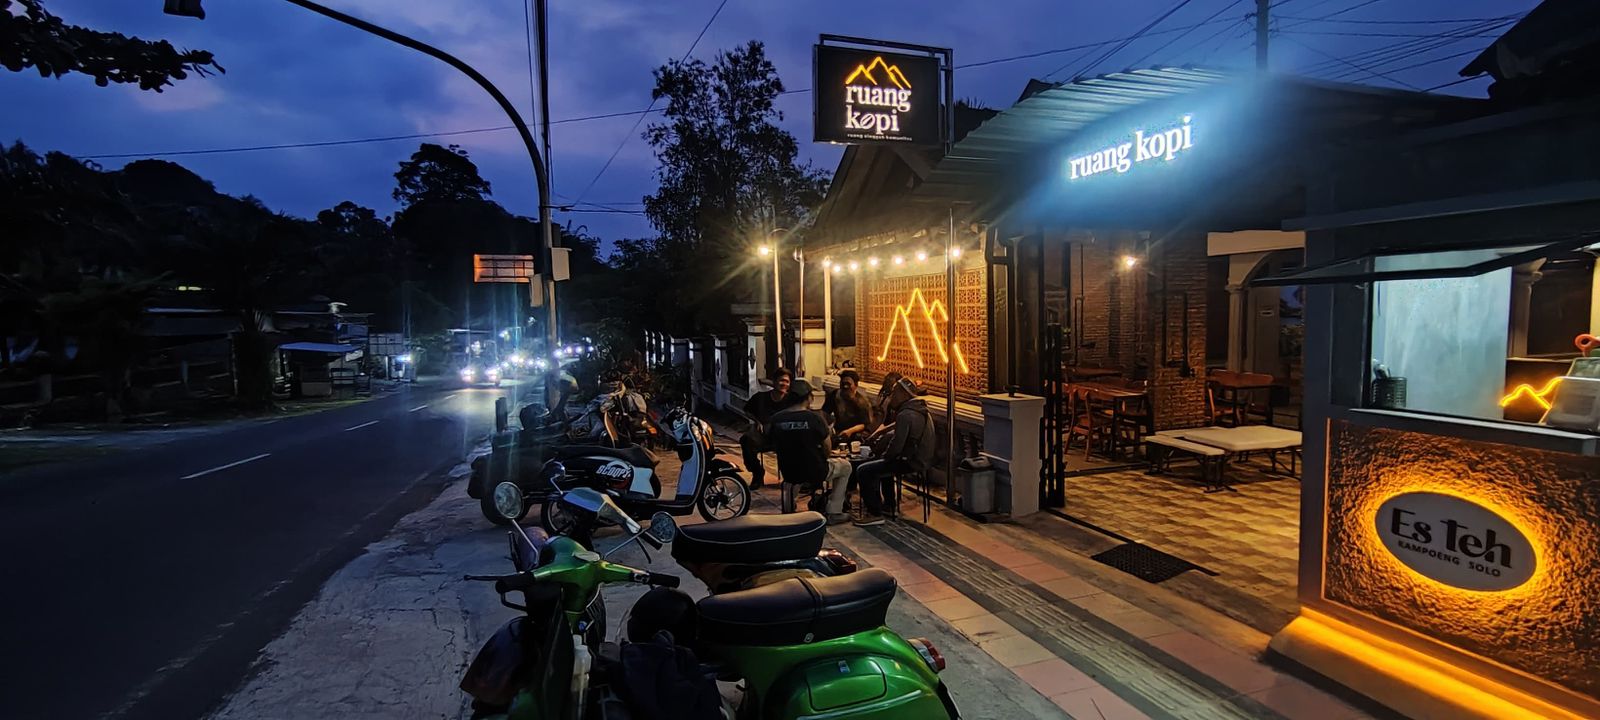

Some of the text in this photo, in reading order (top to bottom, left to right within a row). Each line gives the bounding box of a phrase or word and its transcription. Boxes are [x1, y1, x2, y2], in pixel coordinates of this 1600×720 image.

[846, 85, 911, 112] ruang
[845, 105, 899, 135] kopi
[1070, 115, 1193, 179] ruang kopi
[1391, 507, 1432, 544] Es
[1398, 540, 1501, 577] KAMPOENG SOLO
